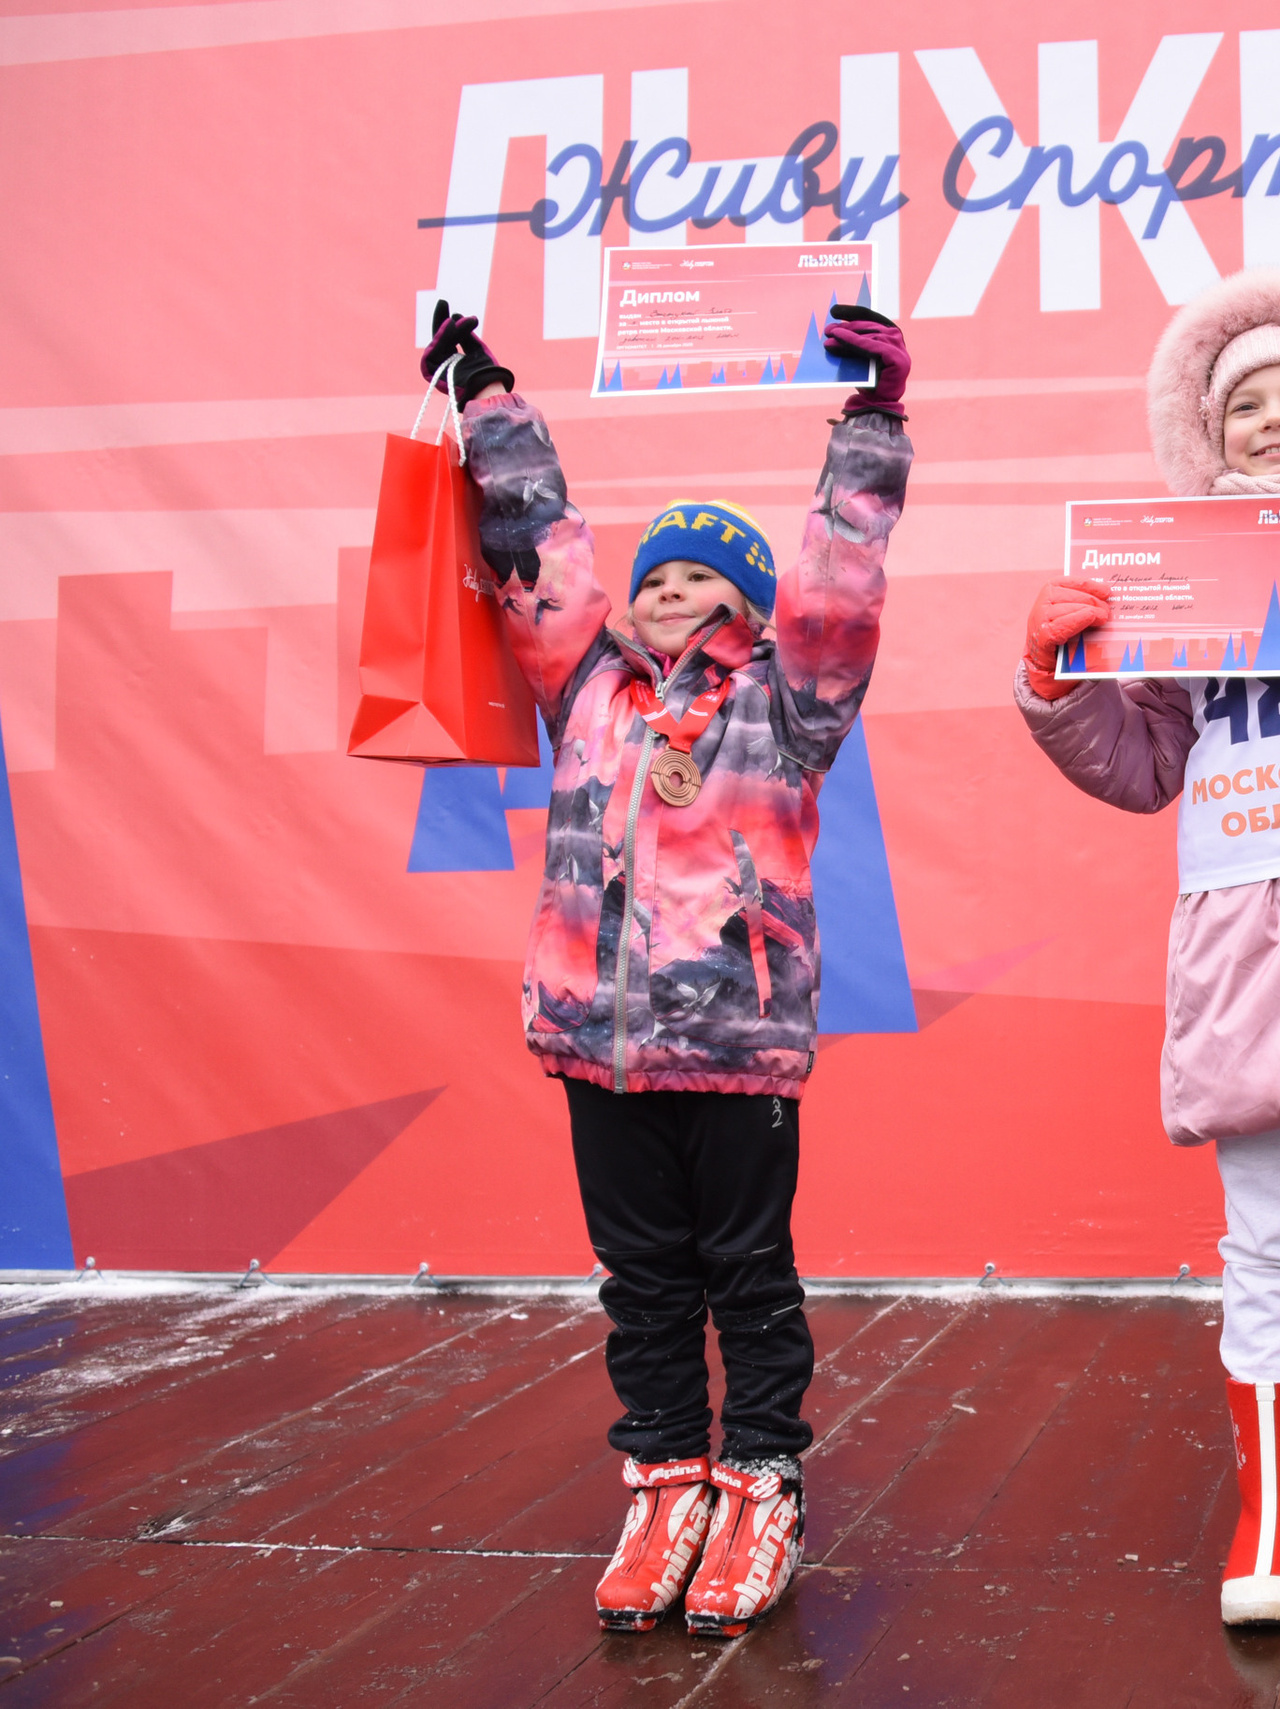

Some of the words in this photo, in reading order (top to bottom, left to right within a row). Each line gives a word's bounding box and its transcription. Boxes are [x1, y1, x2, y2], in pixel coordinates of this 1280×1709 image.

[797, 253, 859, 268] ЛЫЖНЯ
[619, 289, 701, 307] Диплом
[660, 324, 702, 334] Московской
[1082, 549, 1161, 570] Диплом
[1128, 583, 1162, 592] открытой
[1122, 593, 1164, 602] Московской
